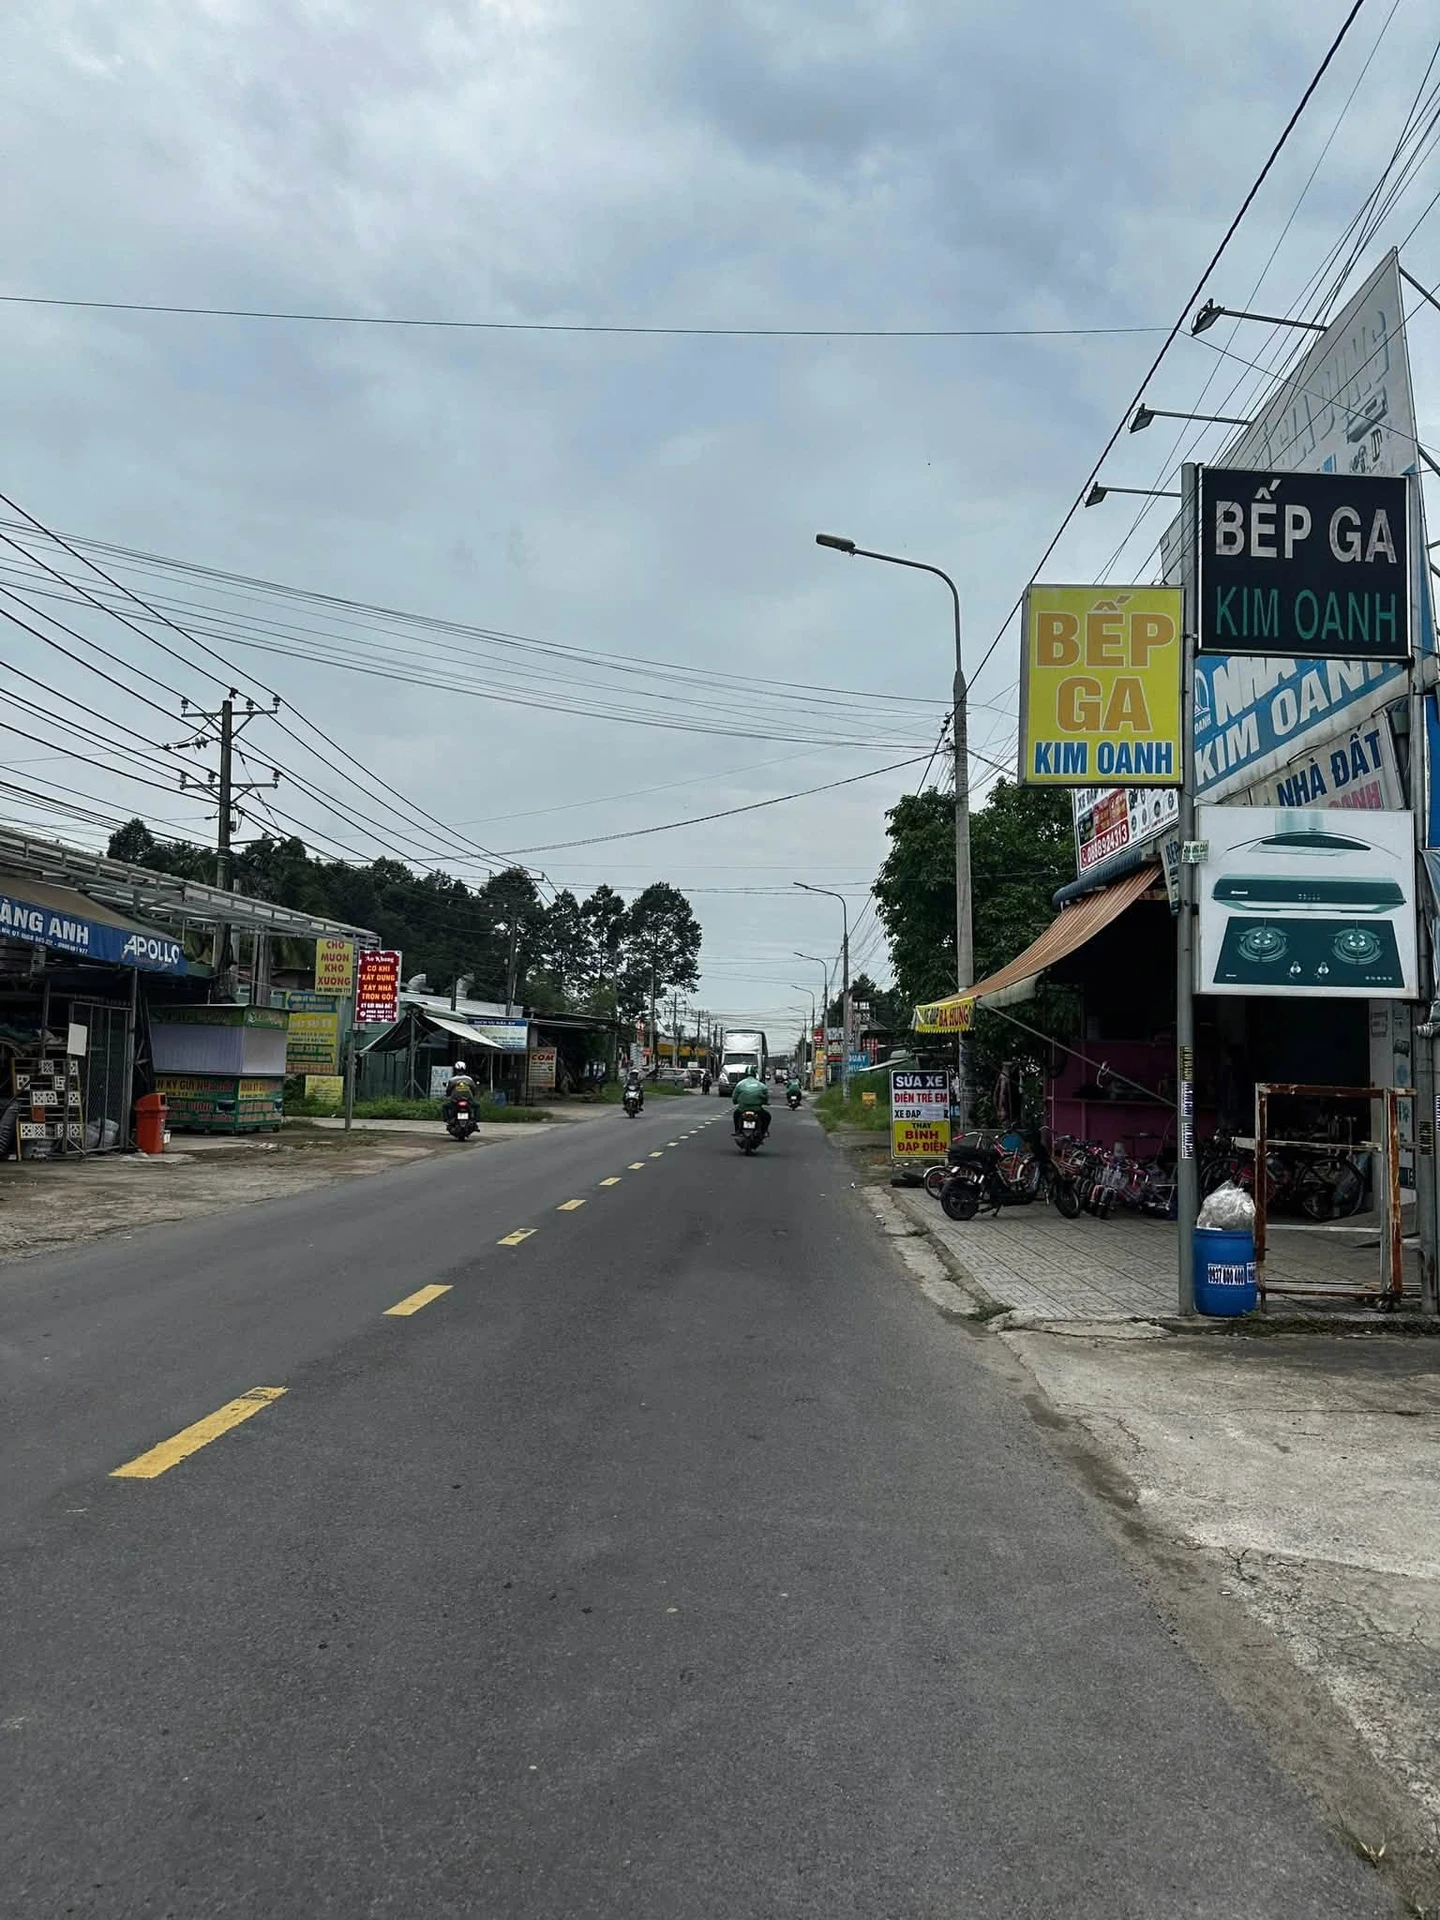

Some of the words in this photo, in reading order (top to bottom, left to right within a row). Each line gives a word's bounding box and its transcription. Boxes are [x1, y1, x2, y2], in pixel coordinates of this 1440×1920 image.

[1216, 480, 1312, 559] BẾP
[1329, 506, 1397, 563] GA
[1216, 586, 1279, 638] KIM
[1294, 589, 1396, 642] OANH
[1035, 594, 1176, 668] BẾP
[1056, 675, 1153, 734] GA
[1034, 741, 1088, 775] KIM
[1097, 741, 1174, 775] OANH
[1194, 711, 1260, 786] KIM
[1276, 757, 1328, 806] NHÀ
[1330, 724, 1382, 788] ĐẤT
[48, 917, 89, 945] ANH
[326, 941, 345, 949] CHO
[122, 934, 180, 964] APOLLO
[324, 963, 344, 972] KHO
[896, 1073, 922, 1088] SỬA
[926, 1075, 943, 1088] XE
[935, 1093, 948, 1103] EM
[894, 1109, 904, 1119] XE
[897, 1142, 920, 1154] ĐẠP
